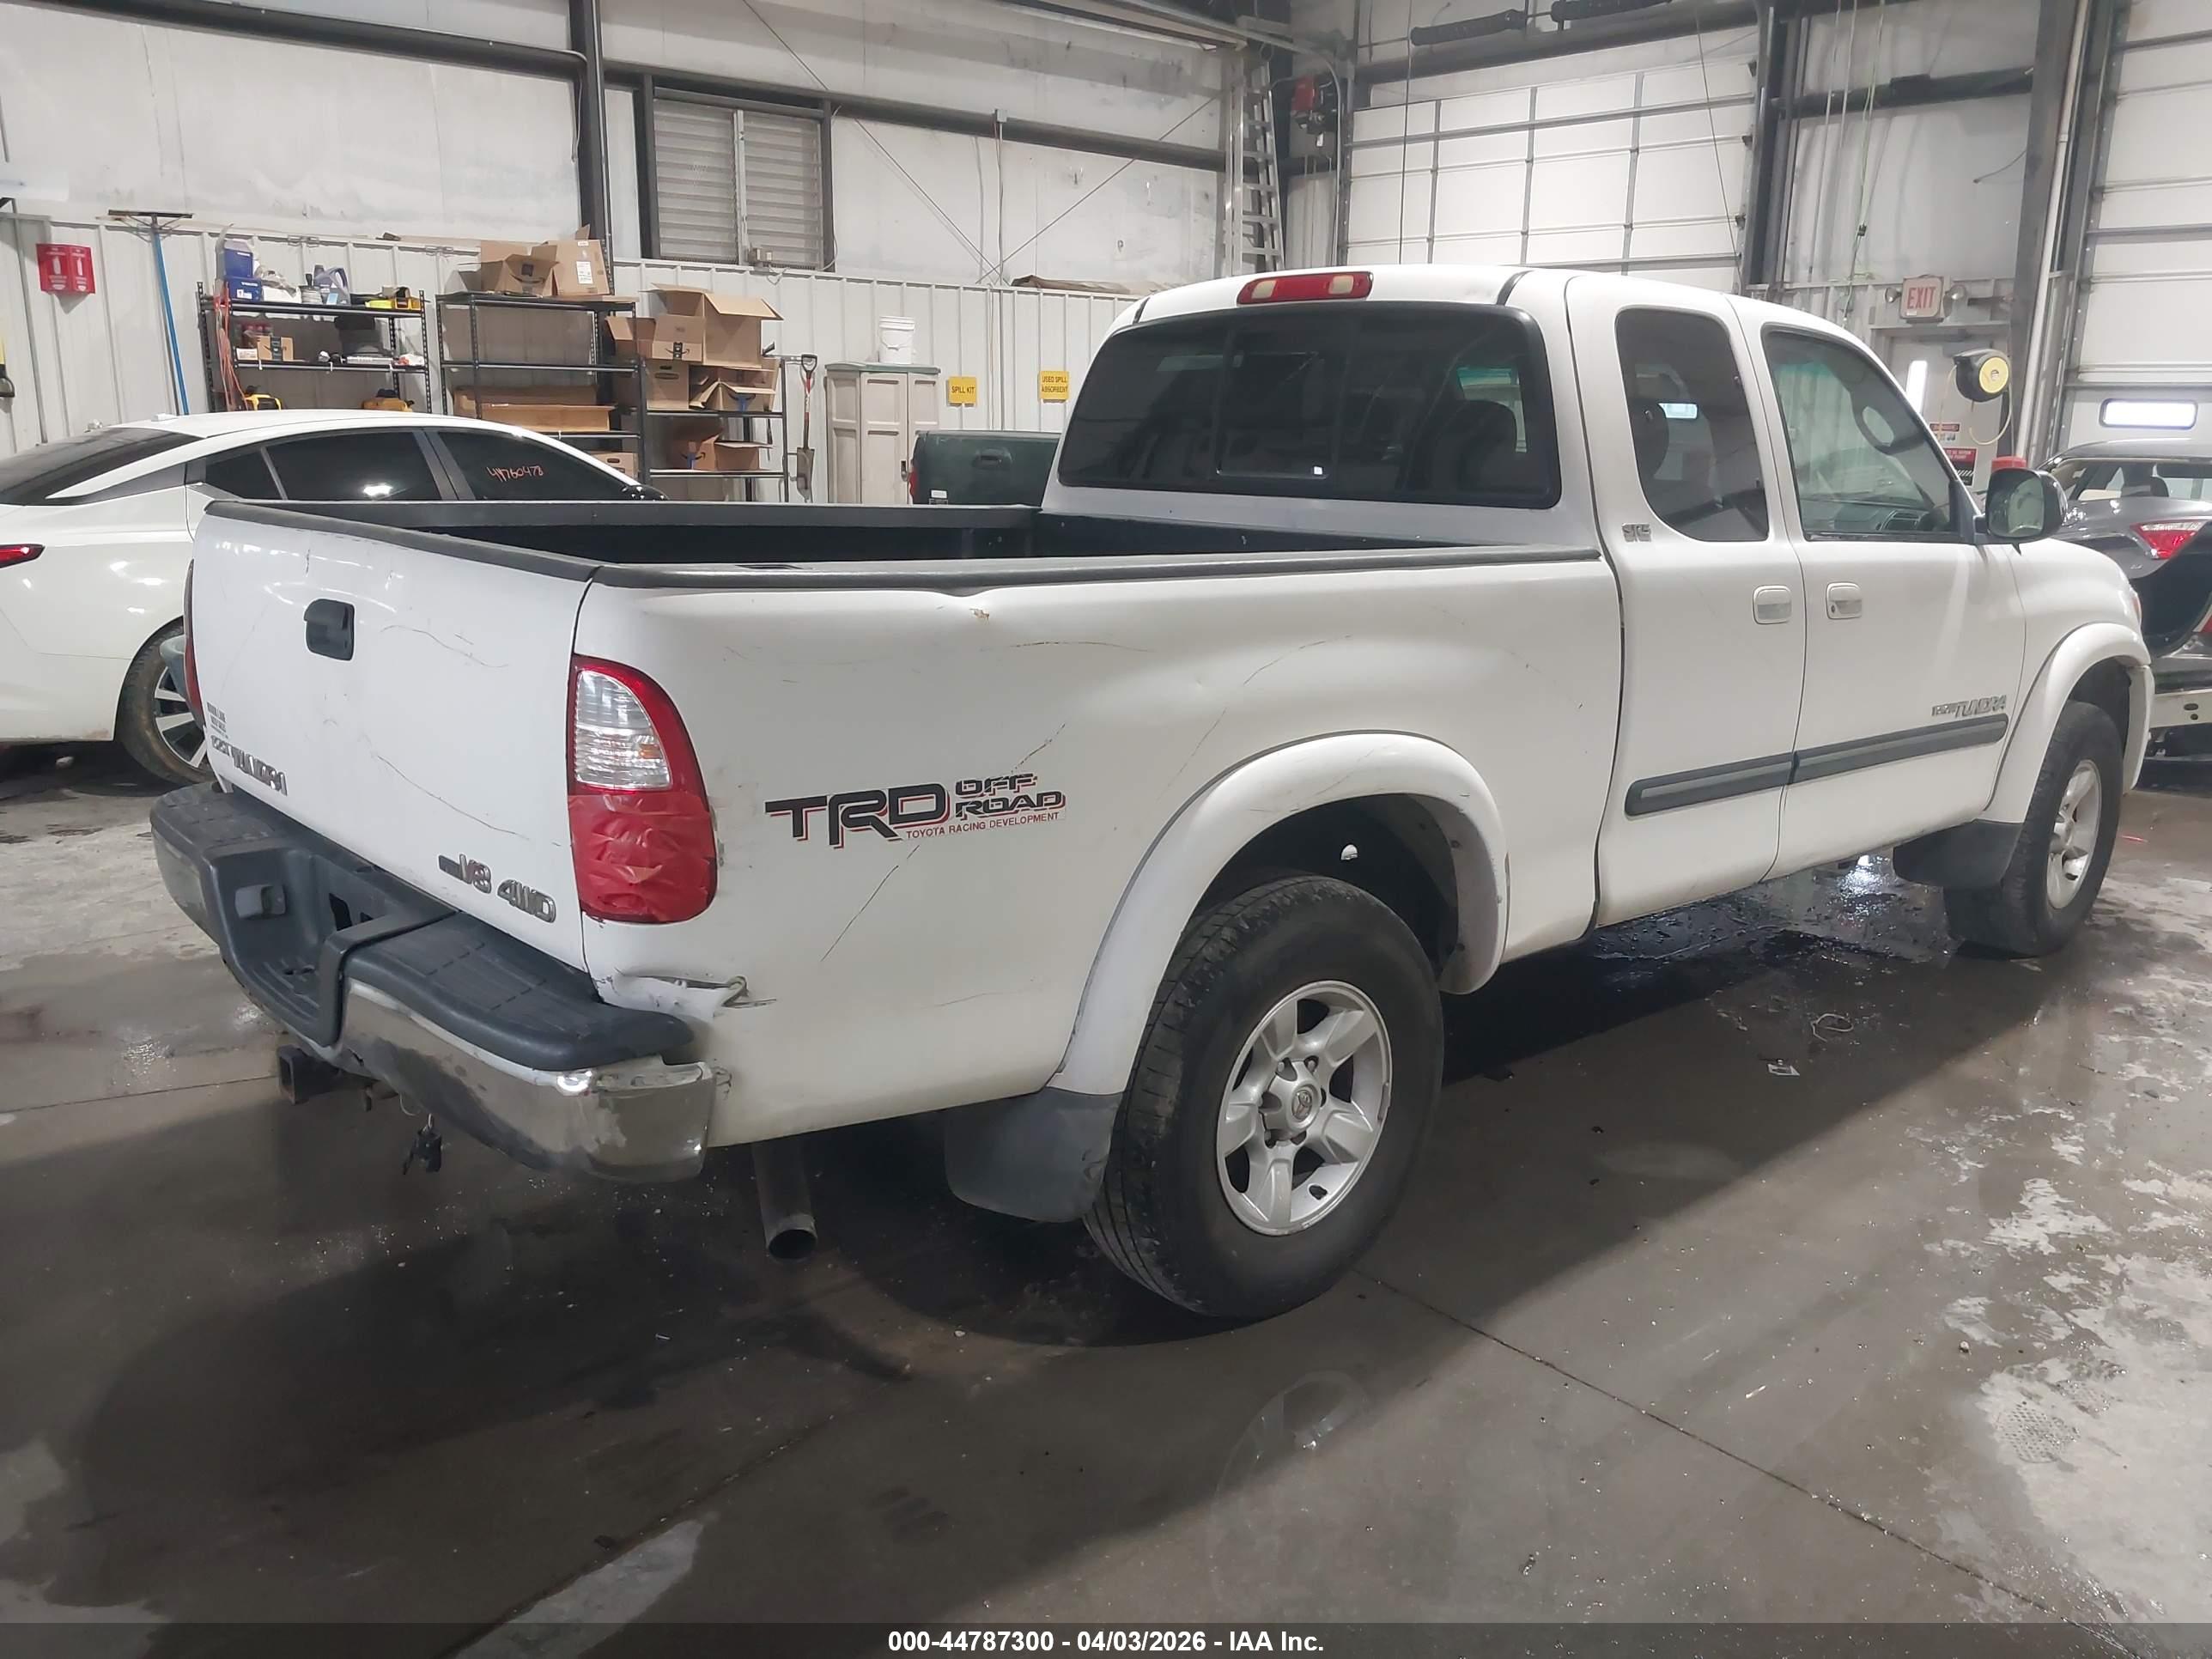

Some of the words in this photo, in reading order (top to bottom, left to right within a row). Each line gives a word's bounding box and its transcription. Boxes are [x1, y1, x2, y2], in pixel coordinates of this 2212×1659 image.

[1907, 286, 1936, 309] EXIT
[955, 773, 1038, 799] OFF
[765, 782, 950, 850] TRD
[955, 790, 1066, 821] ROAD
[906, 826, 945, 840] TOYOTA
[949, 821, 987, 835] RACING
[989, 811, 1060, 829] DEVELOPMENT
[459, 853, 492, 894] V8
[497, 878, 556, 924] 4WD
